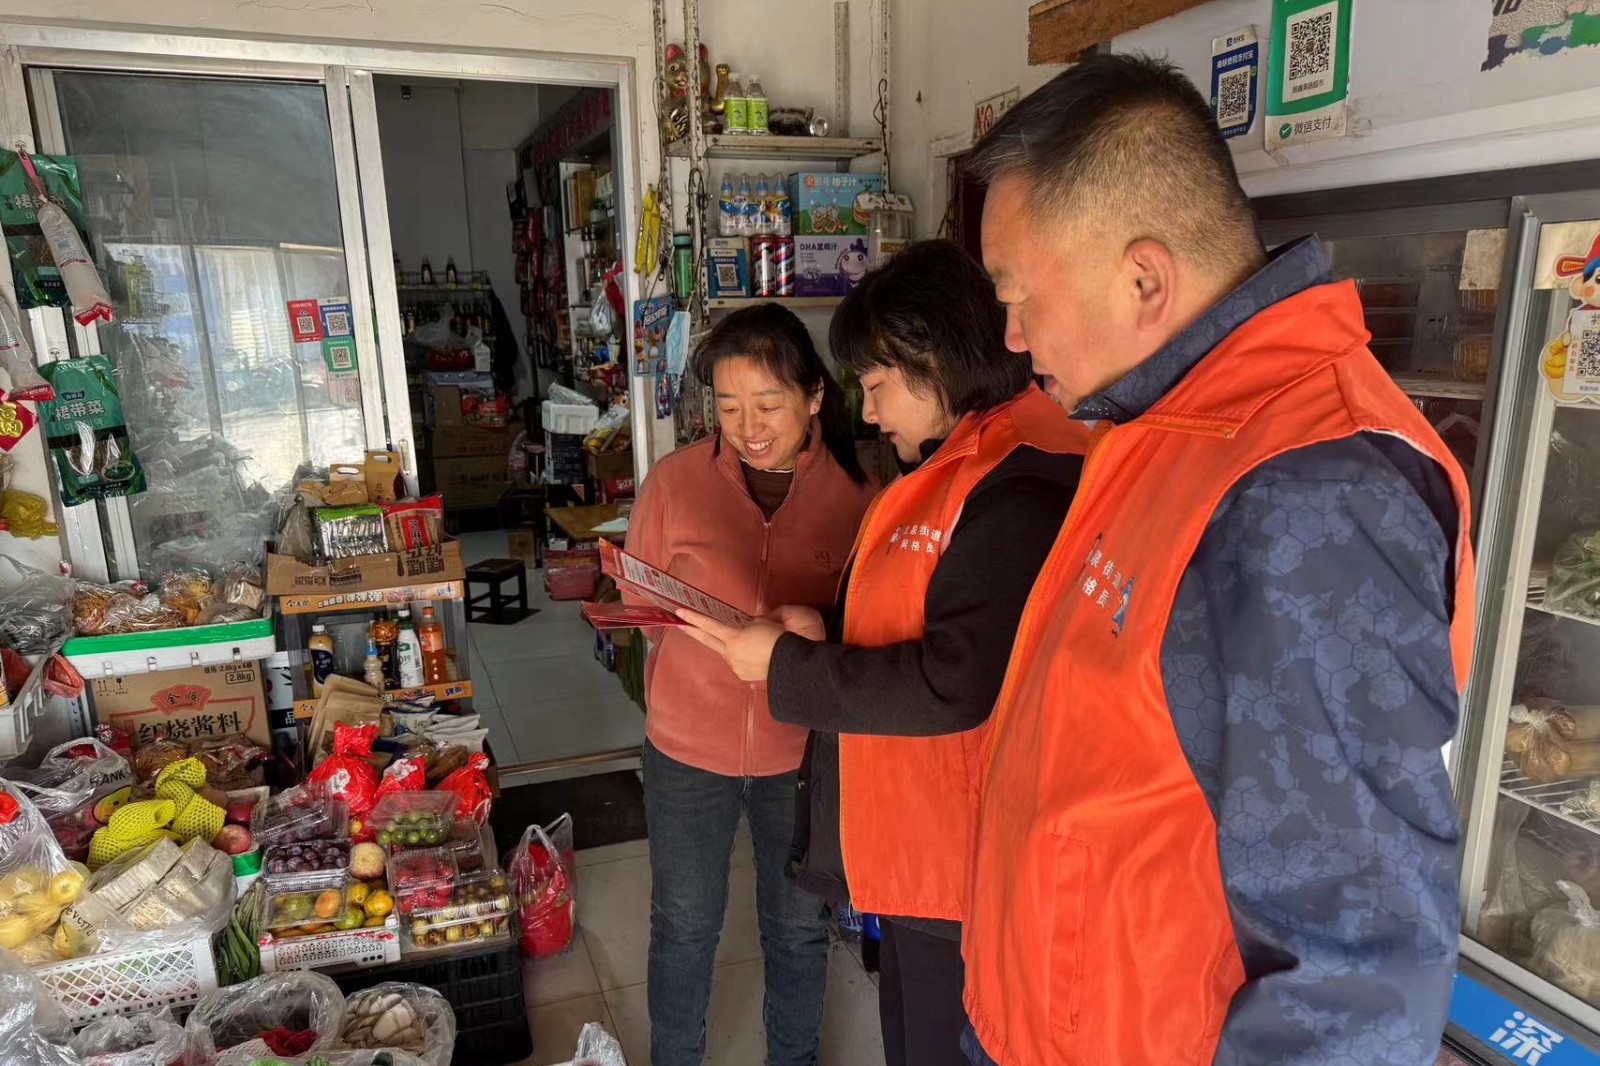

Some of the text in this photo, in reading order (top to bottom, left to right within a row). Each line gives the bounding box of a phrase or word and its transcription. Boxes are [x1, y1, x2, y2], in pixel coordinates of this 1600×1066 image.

[1294, 115, 1332, 135] 微信支付
[55, 399, 105, 422] 裙带菜
[408, 519, 423, 548] 芝麻
[1086, 549, 1122, 590] 泉街道
[229, 673, 252, 682] 2.8kg
[139, 711, 241, 743] 红烧酱料
